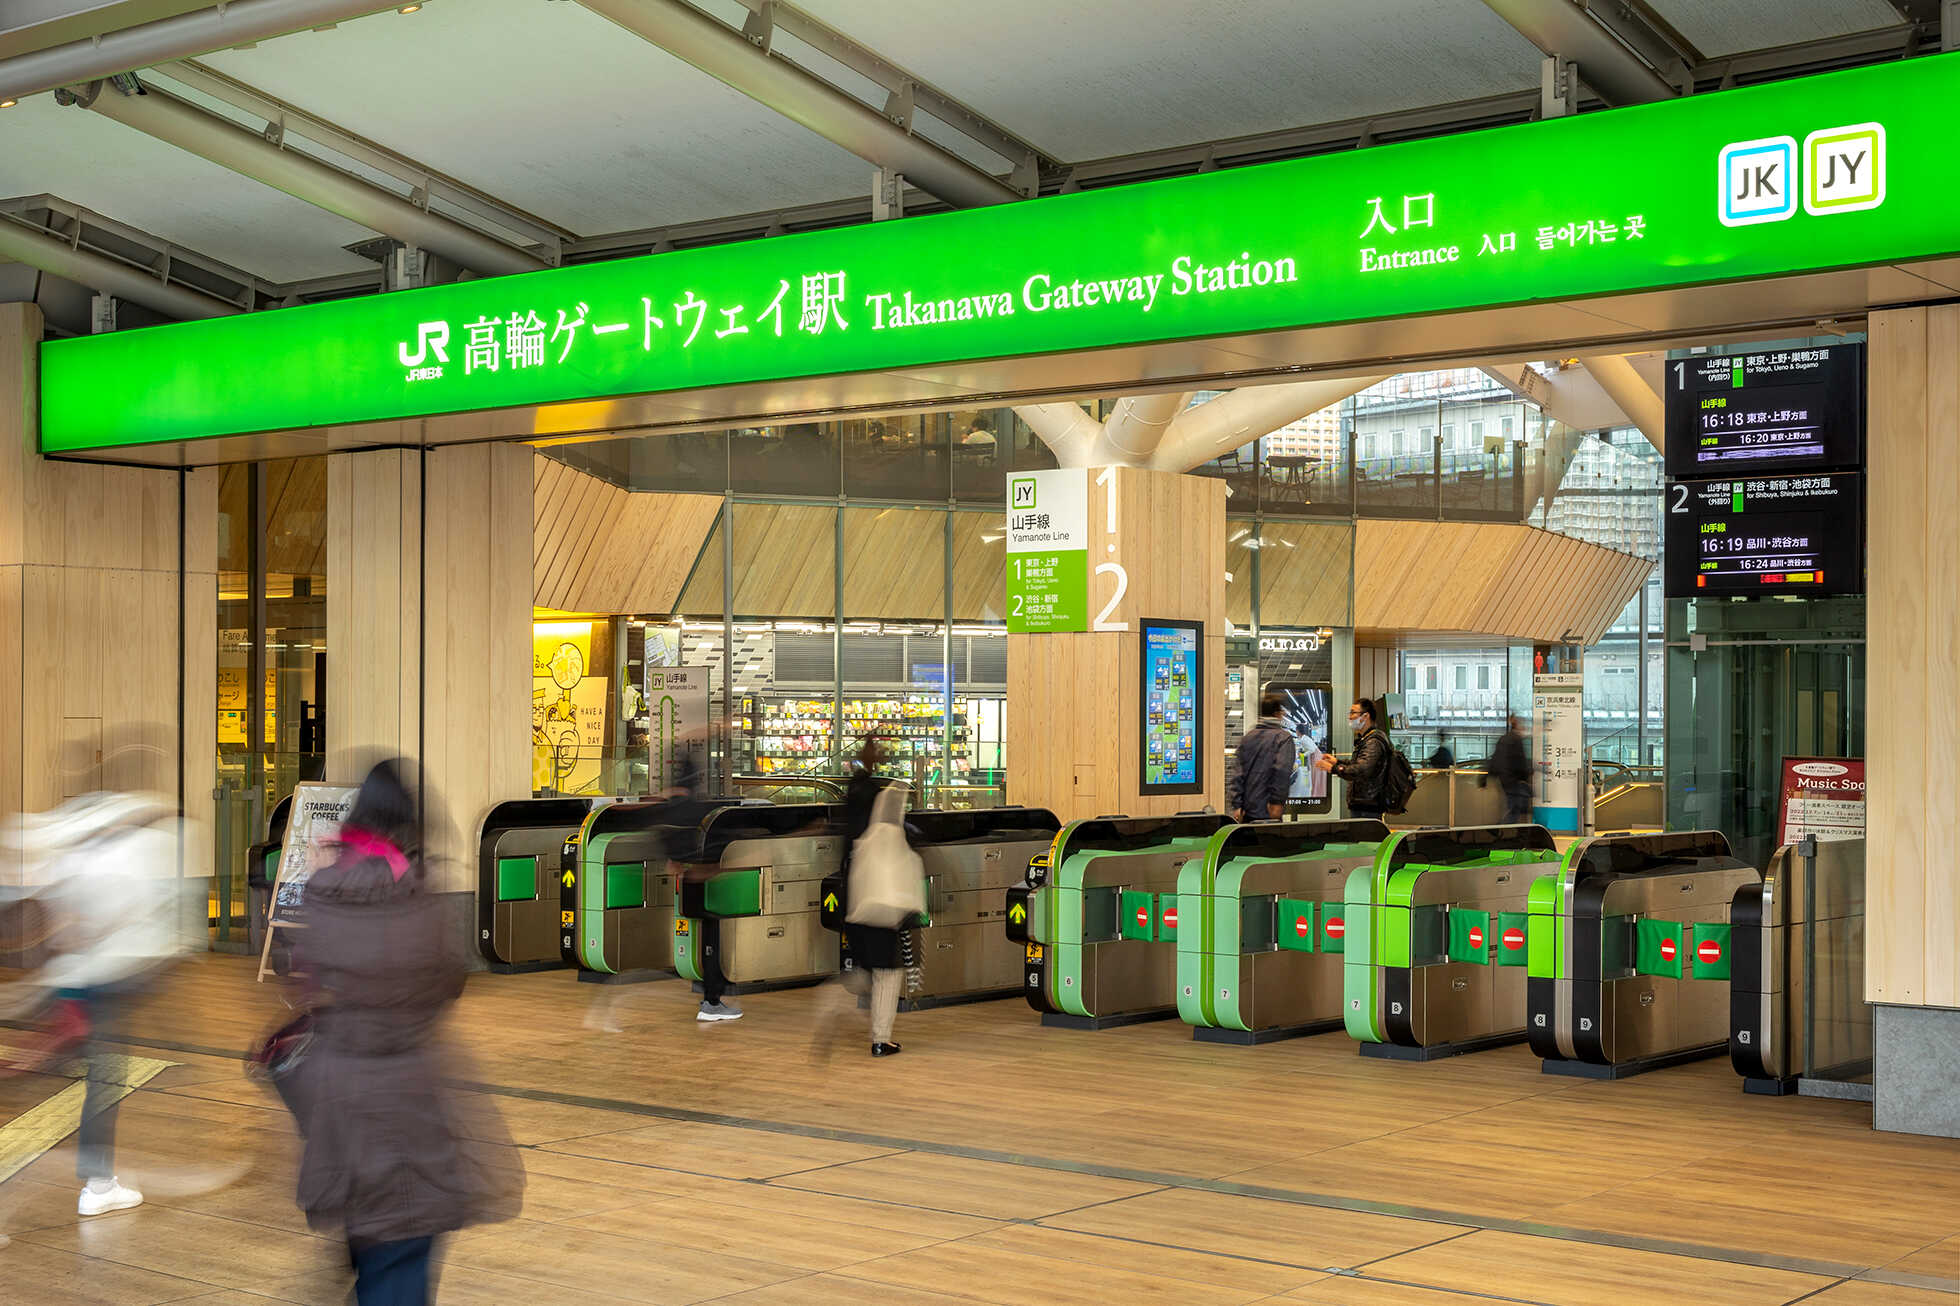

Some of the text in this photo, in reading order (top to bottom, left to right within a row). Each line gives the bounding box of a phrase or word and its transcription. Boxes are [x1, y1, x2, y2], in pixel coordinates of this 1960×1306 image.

[1822, 149, 1867, 189] JY
[1737, 162, 1780, 201] JK
[1358, 192, 1436, 239] 入口
[1535, 214, 1647, 250] 들어가는 곳
[1476, 231, 1517, 258] 入口
[1359, 240, 1460, 273] Entrance
[865, 251, 1298, 331] Takanawa Gateway Station
[462, 269, 850, 376] 高輪ゲートウェイ駅
[399, 320, 450, 367] JR
[1707, 358, 1731, 369] 山手線
[1673, 362, 1686, 391] 1
[1701, 398, 1727, 409] 山手線
[1702, 412, 1744, 428] 16:18
[1740, 433, 1769, 444] 16:20
[1707, 482, 1731, 492] 山手線
[1015, 486, 1033, 502] JY
[1671, 484, 1689, 514] 2
[1012, 513, 1051, 531] 山手線
[1701, 523, 1727, 533] 山手線
[1012, 532, 1070, 543] Yamanote Line
[1701, 538, 1744, 552] 16:19
[1740, 559, 1769, 569] 16:24
[1013, 559, 1021, 581] 1
[1093, 562, 1129, 632] 2
[1012, 595, 1024, 617] 2
[222, 631, 240, 641] Fare
[653, 677, 662, 687] JY
[666, 673, 687, 684] 山手線
[587, 736, 600, 745] DAY
[1555, 747, 1561, 757] 3
[1554, 769, 1561, 778] 4
[1797, 777, 1838, 789] Music
[304, 801, 350, 812] STARBUCKS
[311, 811, 340, 822] COFFEE
[1222, 990, 1228, 998] 7
[1353, 1000, 1359, 1009] 7
[1393, 1003, 1399, 1013] 8
[1538, 1015, 1543, 1025] 8
[1582, 1019, 1588, 1029] 9
[1742, 1032, 1748, 1042] 9
